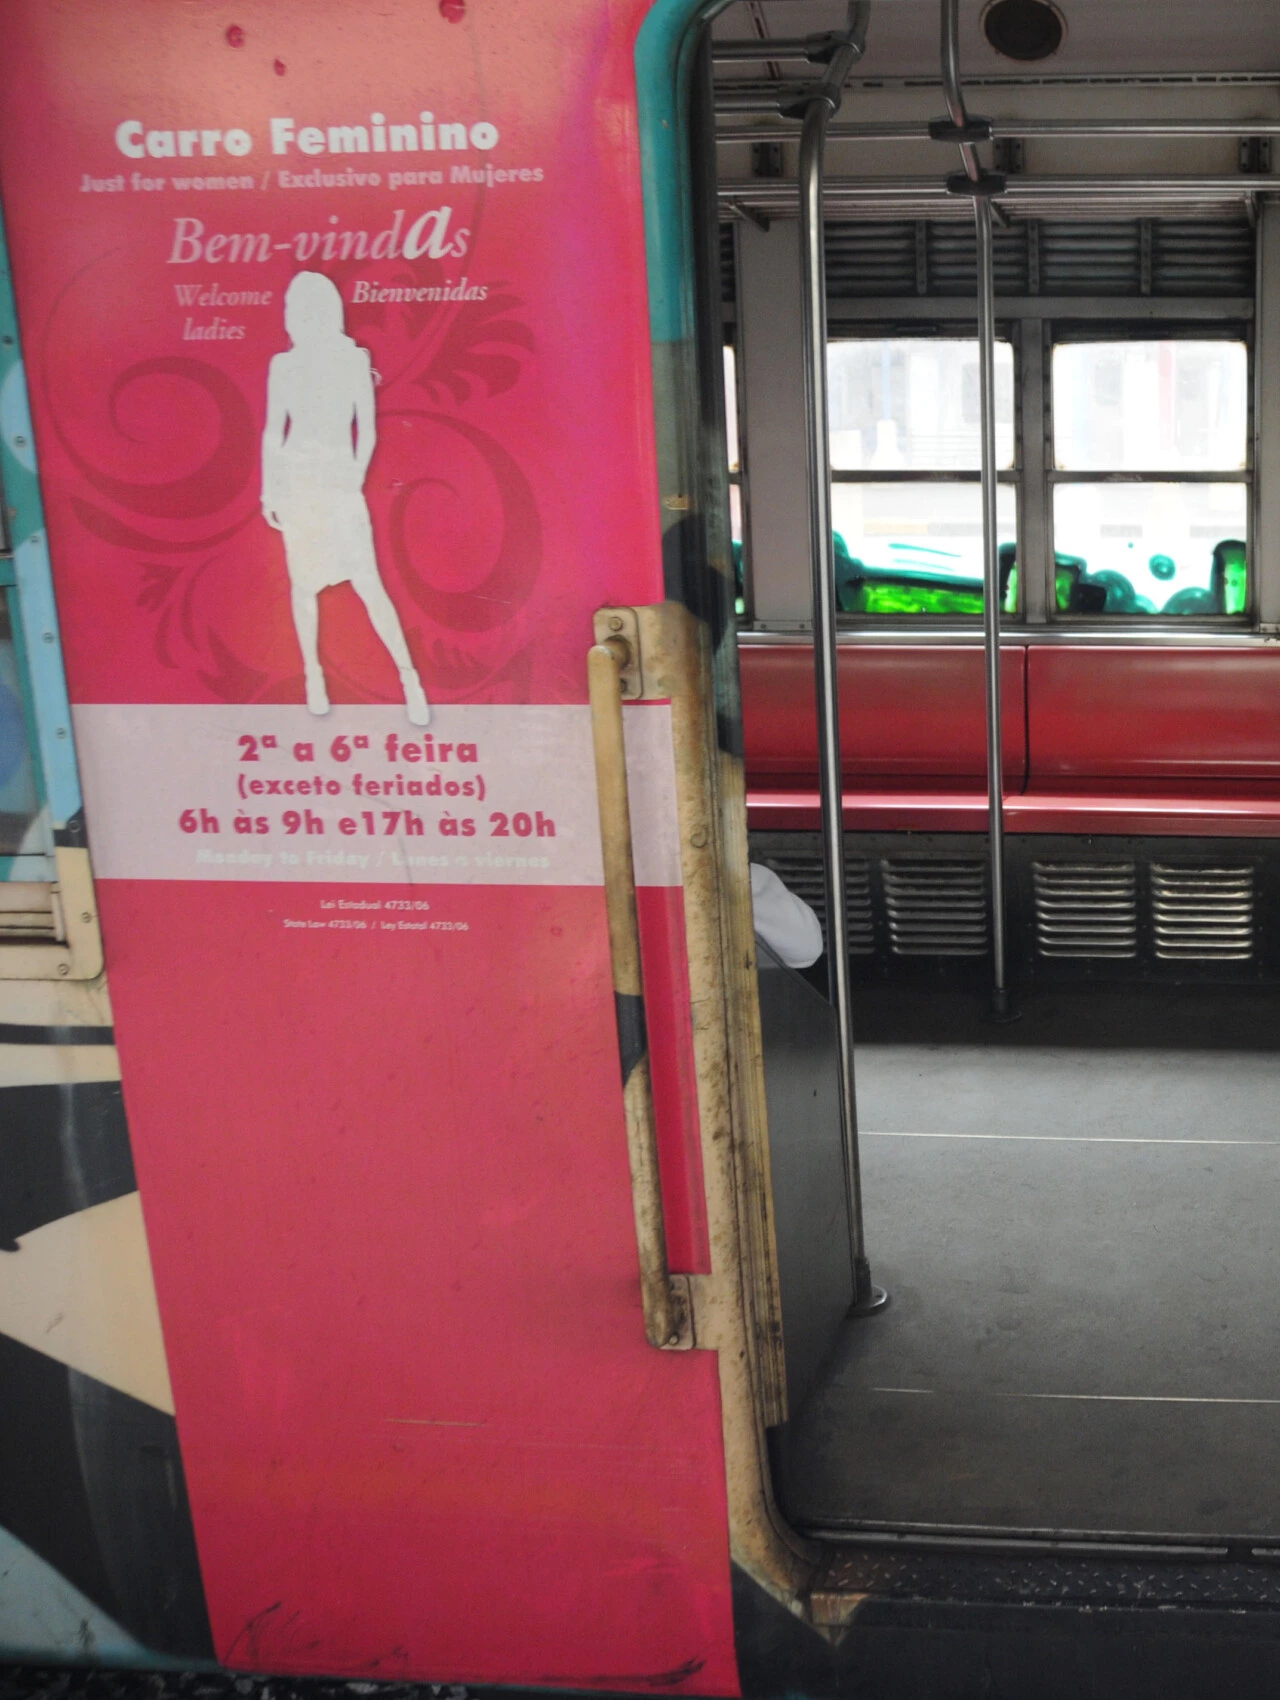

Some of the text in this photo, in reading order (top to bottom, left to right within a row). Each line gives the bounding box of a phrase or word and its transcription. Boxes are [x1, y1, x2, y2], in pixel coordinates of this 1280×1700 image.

[115, 111, 499, 159] Carro Feminino
[80, 174, 124, 193] Just
[132, 172, 164, 191] for
[172, 174, 254, 190] women
[278, 168, 381, 189] Exclusivo
[389, 169, 443, 191] para
[450, 164, 544, 188] Mujeres
[167, 205, 471, 264] Bem-vindas
[174, 284, 273, 307] Welcome
[352, 279, 488, 304] Bienvenidas
[183, 318, 246, 341] ladies
[293, 741, 314, 762] a
[385, 733, 478, 763] feira
[237, 772, 486, 802] (exceto feriados)
[179, 808, 219, 835] 6h
[233, 809, 270, 835] às
[283, 809, 324, 836] 9h
[438, 810, 476, 837] às
[490, 810, 556, 838] 20h
[196, 849, 273, 867] Monday
[279, 851, 301, 865] to
[306, 850, 369, 868] Friday
[391, 852, 449, 867] Lunes
[473, 852, 551, 869] viernes
[338, 900, 381, 911] Estadual
[384, 901, 430, 912] 4733/06
